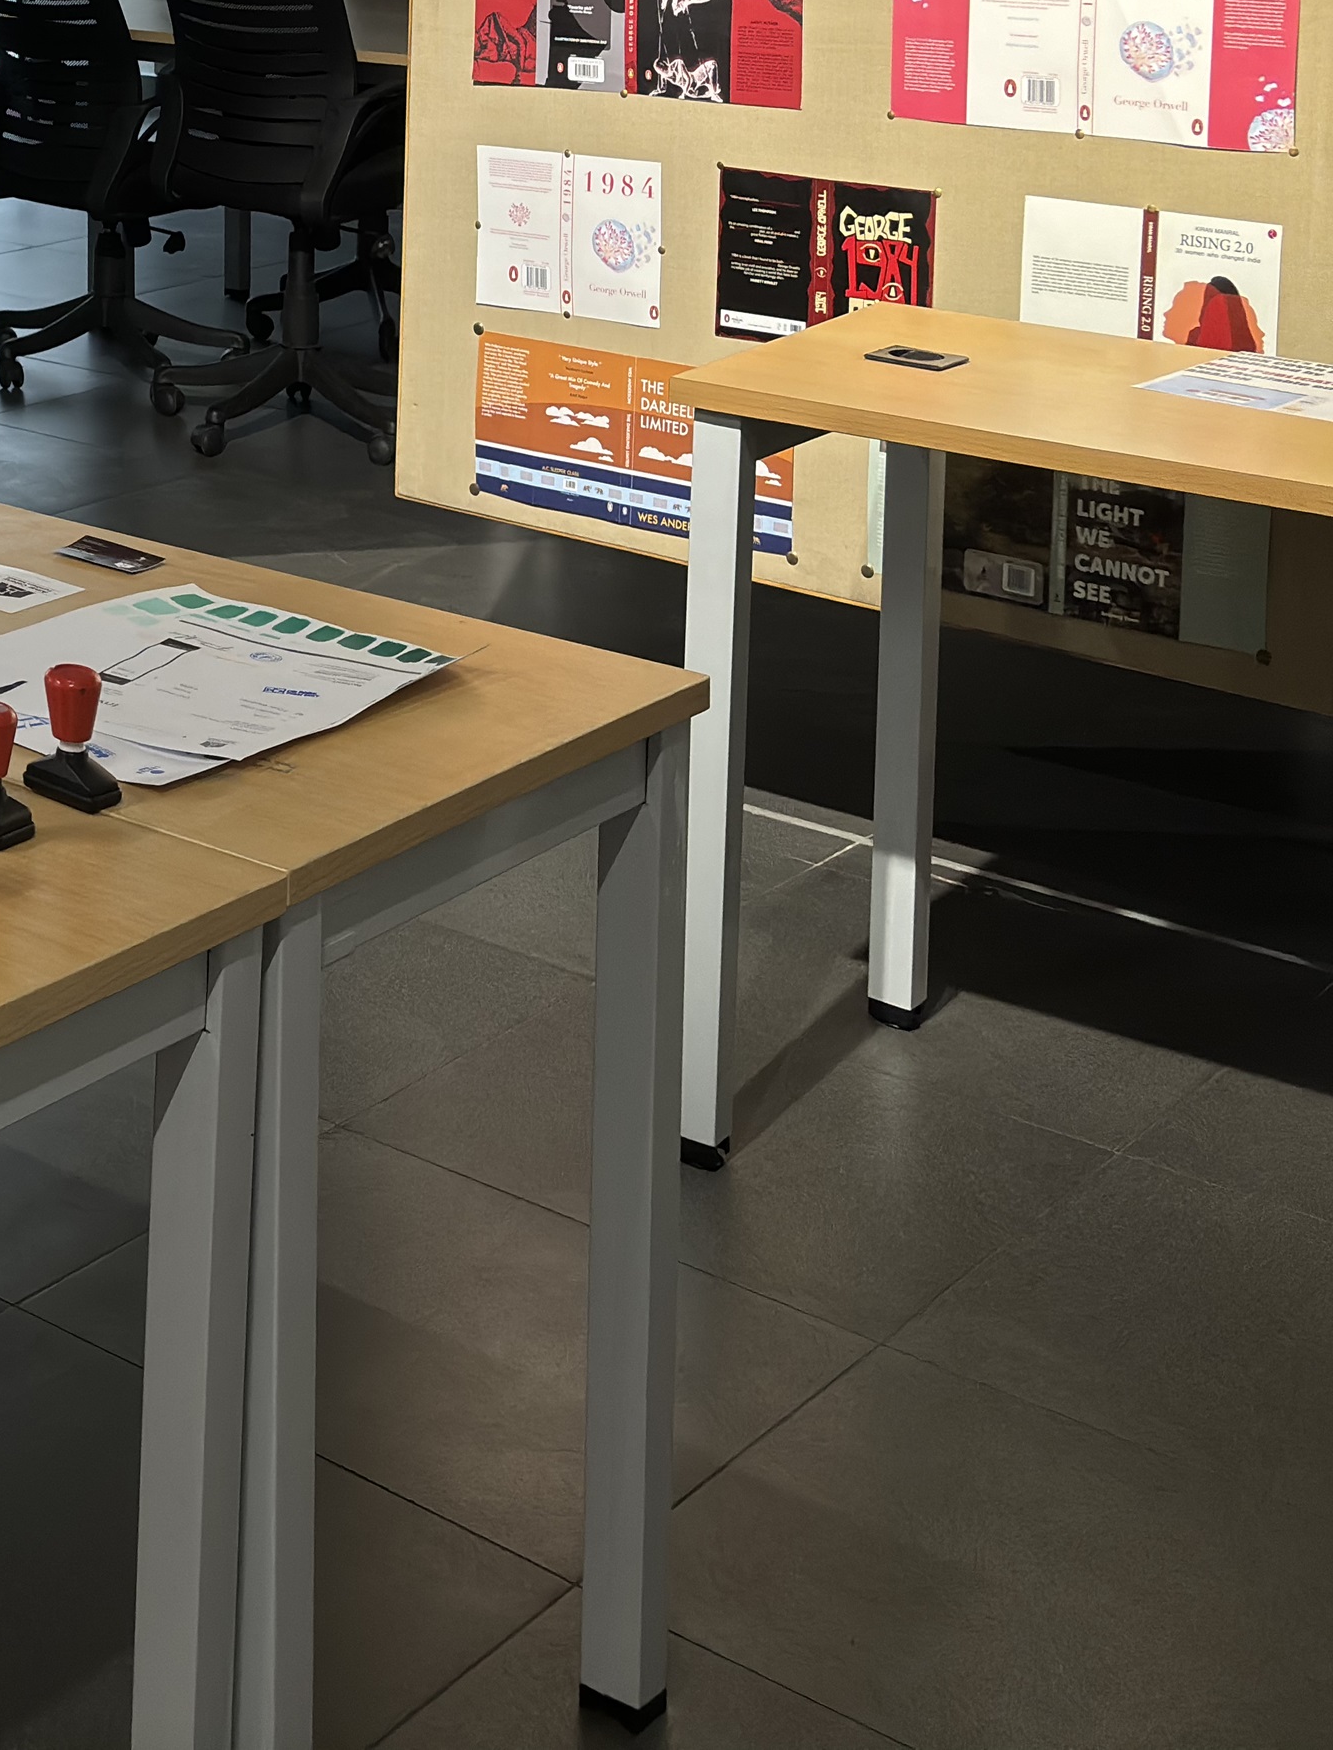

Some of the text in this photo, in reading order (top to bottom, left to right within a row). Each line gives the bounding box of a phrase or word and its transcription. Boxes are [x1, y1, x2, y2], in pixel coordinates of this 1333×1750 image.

[1113, 95, 1189, 112] George Orwell
[563, 169, 572, 205] 1984
[584, 170, 654, 199] 1984
[839, 206, 914, 244] GEORGE
[817, 224, 828, 256] GEORGE
[1180, 234, 1254, 254] RISING 2.0
[589, 283, 647, 299] George Orwell
[1141, 275, 1154, 332] RISING 2.0
[641, 379, 664, 396] THE
[641, 397, 693, 419] DARJEEL
[640, 415, 688, 436] LIMITED
[637, 512, 659, 524] WES
[1076, 499, 1144, 527] LIGHT
[1075, 526, 1113, 549] WE
[1074, 553, 1170, 587] CANNOT
[1073, 581, 1112, 603] SEE
